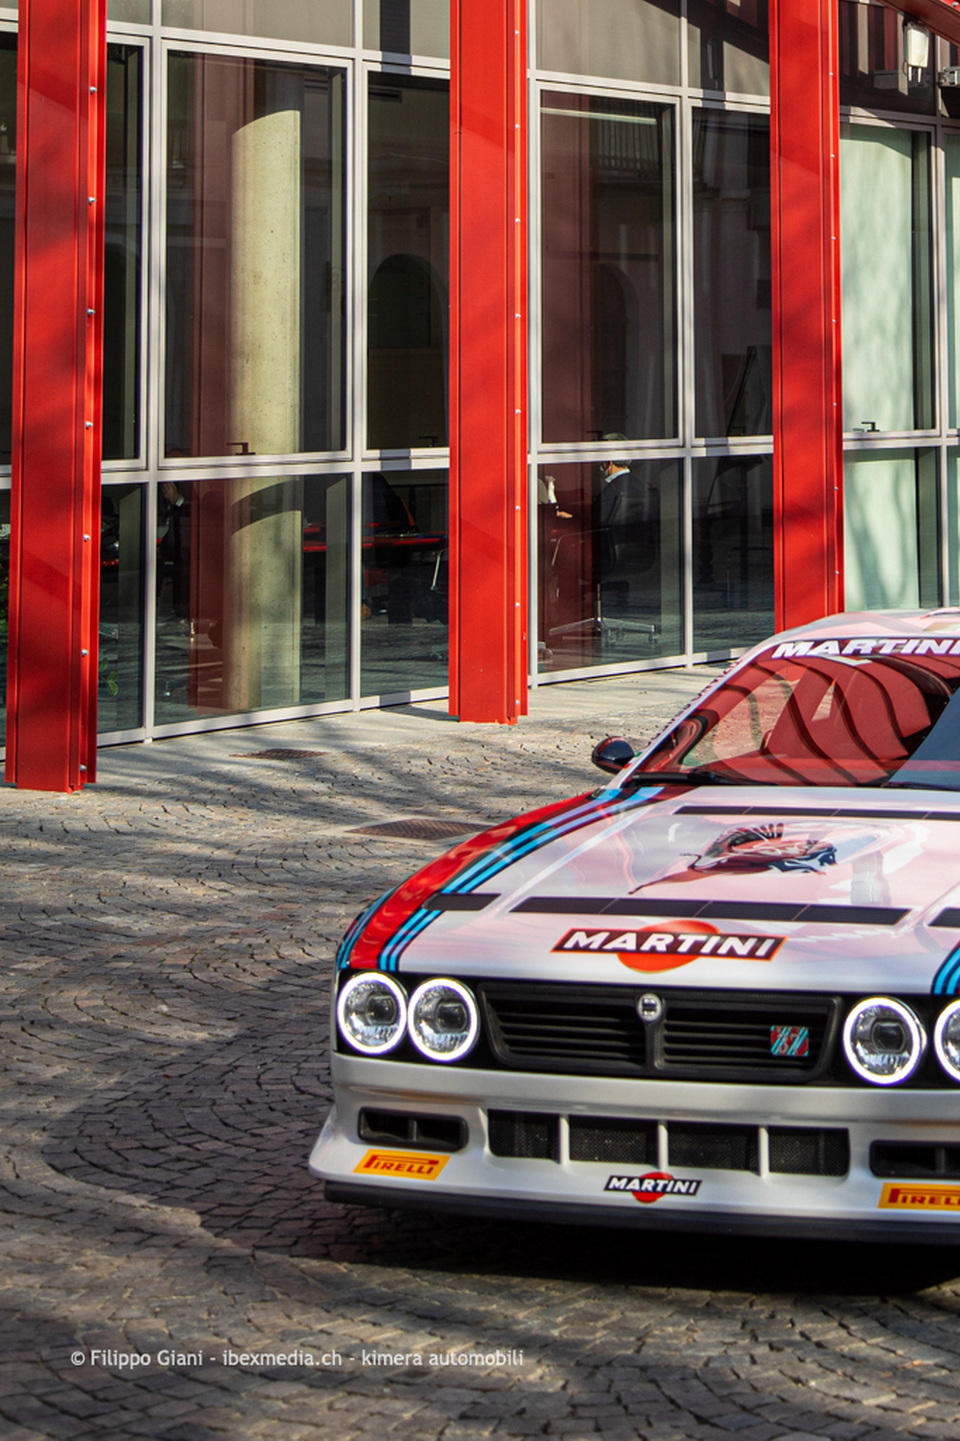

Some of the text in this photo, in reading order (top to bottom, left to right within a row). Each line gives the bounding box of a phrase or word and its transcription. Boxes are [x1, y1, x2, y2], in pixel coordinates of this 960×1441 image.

[562, 931, 776, 956] MARTINI
[363, 1155, 440, 1175] PIRELLI
[609, 1177, 698, 1195] MARTINI
